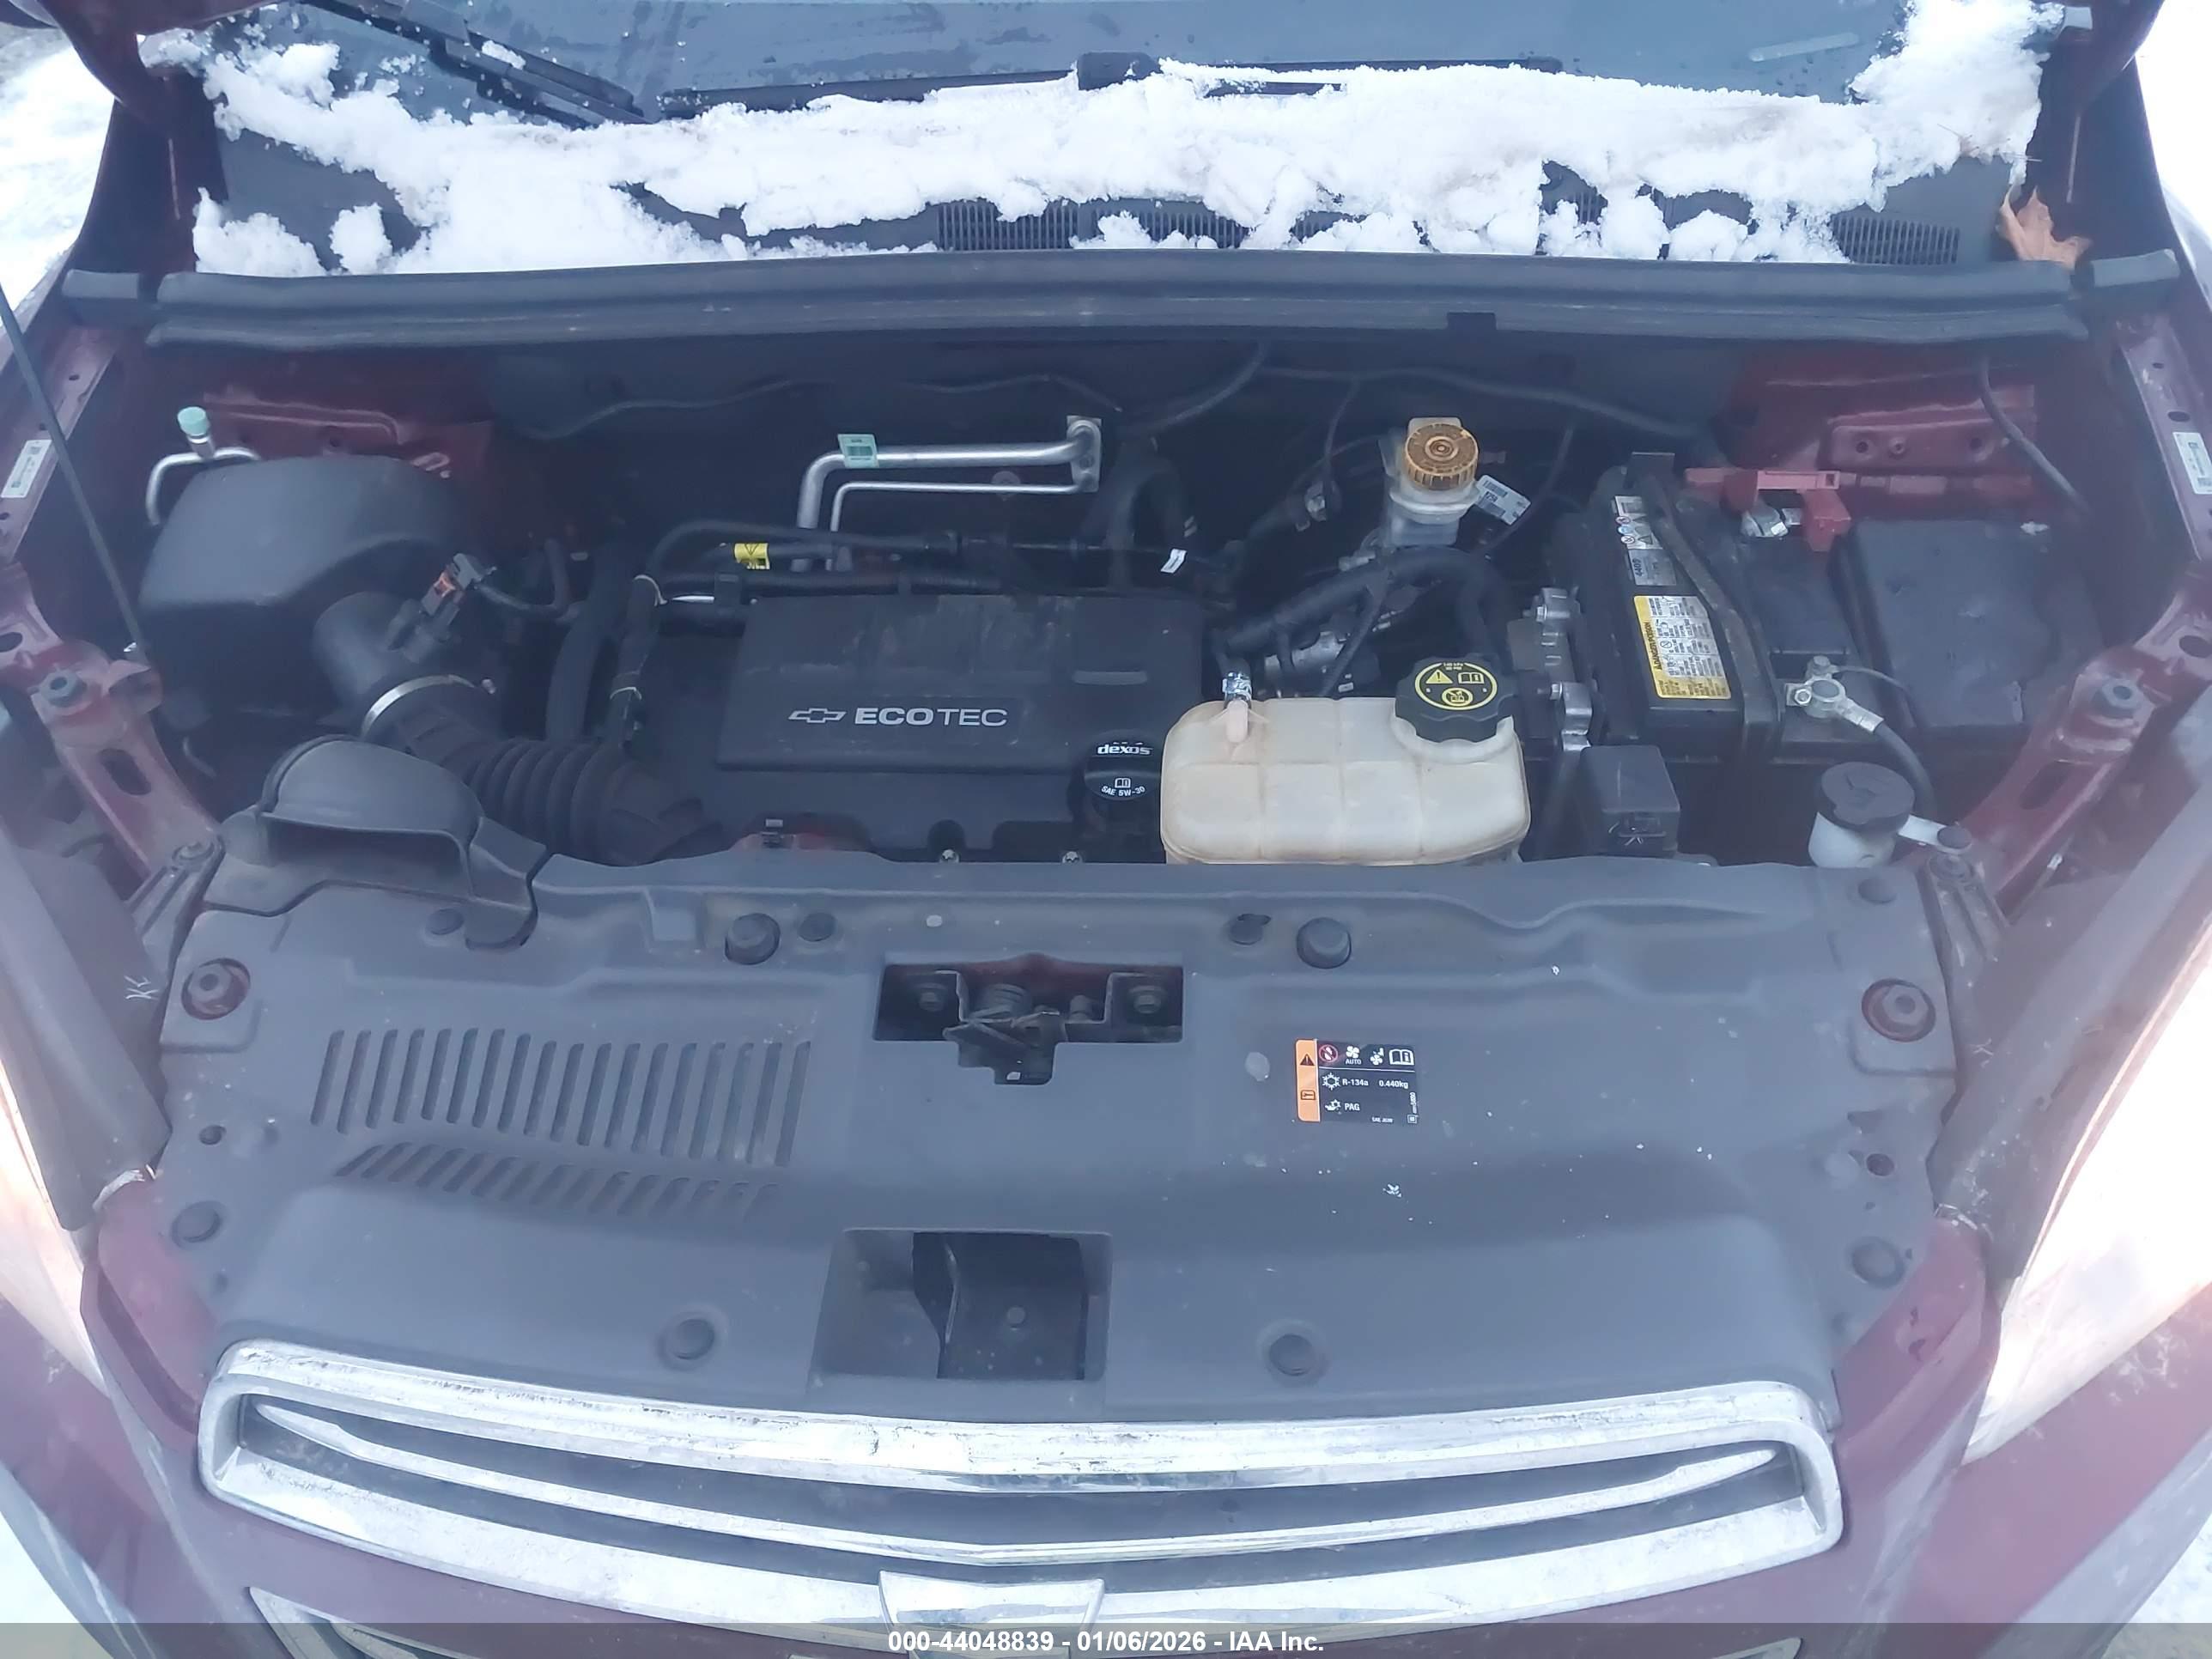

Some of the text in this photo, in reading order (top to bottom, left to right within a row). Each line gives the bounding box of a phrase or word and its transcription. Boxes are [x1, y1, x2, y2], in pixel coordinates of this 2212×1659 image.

[854, 707, 1008, 727] ECOTEC
[1097, 742, 1153, 755] dexos
[1101, 786, 1146, 797] SAE 5W-30
[1342, 1079, 1409, 1090] R-134a 0.440kg
[1344, 1103, 1361, 1112] PAG
